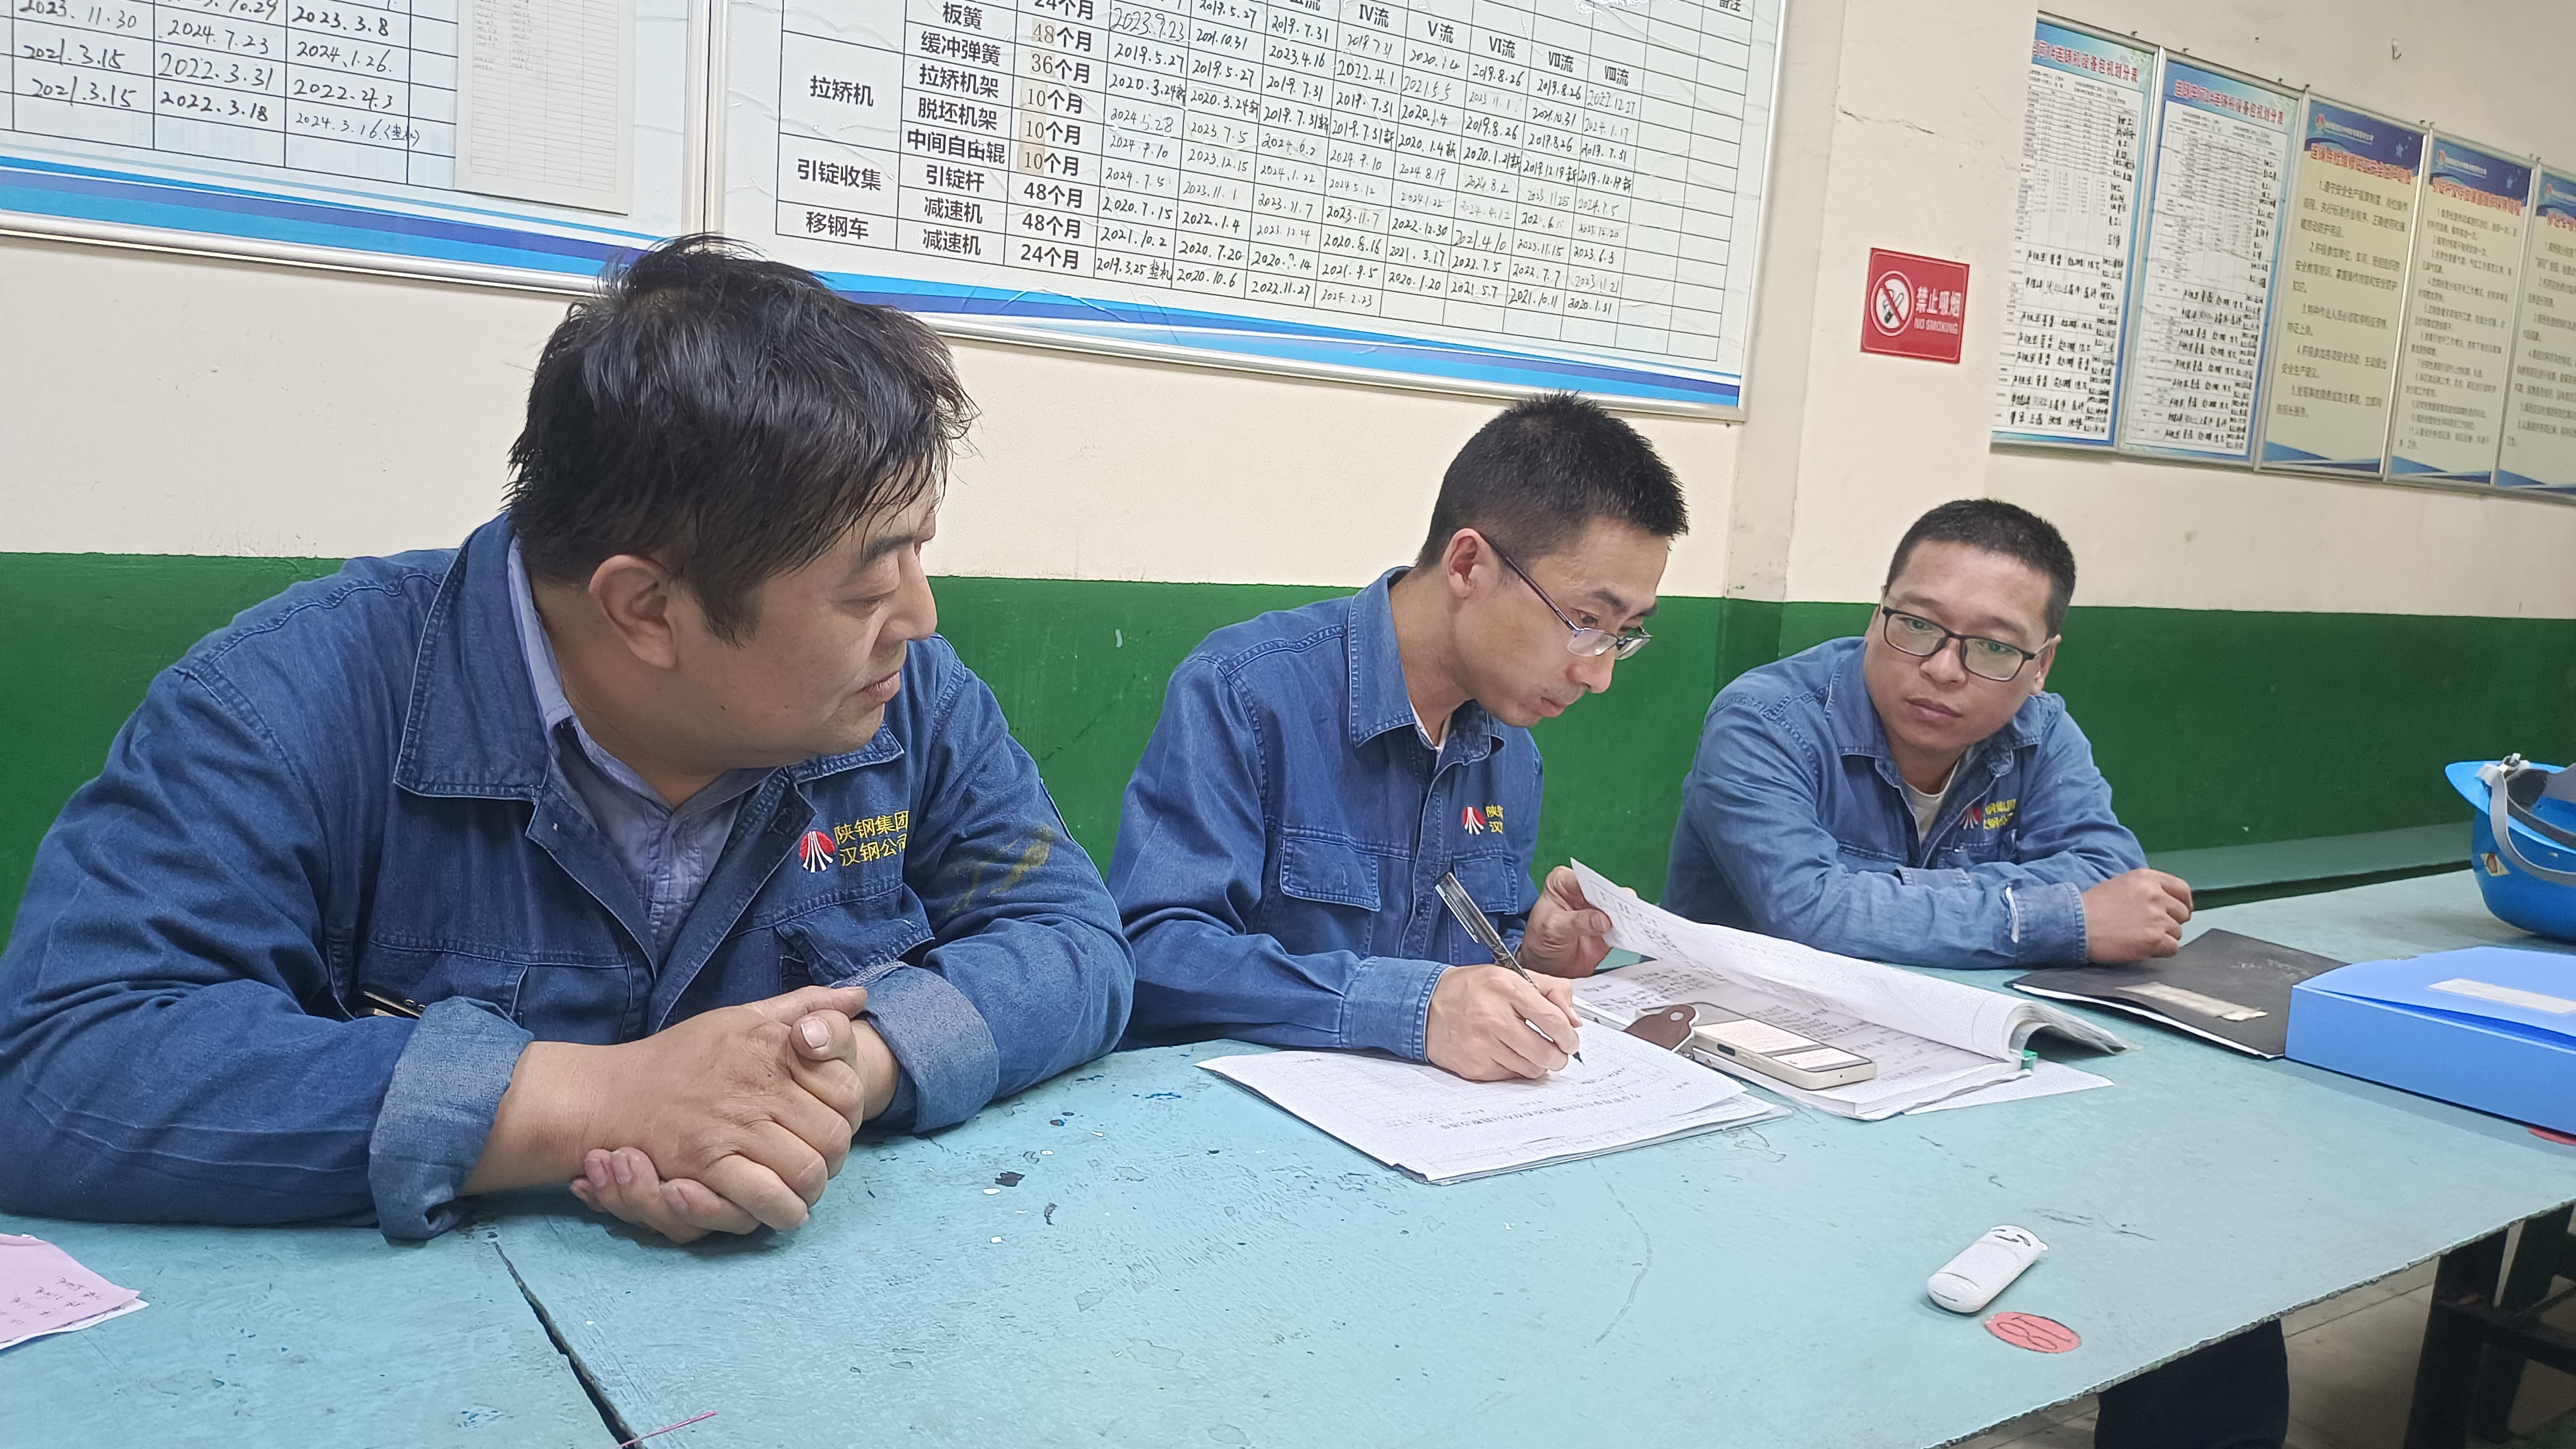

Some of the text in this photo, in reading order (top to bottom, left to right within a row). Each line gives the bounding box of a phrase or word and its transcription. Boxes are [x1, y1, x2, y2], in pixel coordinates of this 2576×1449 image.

[292, 7, 389, 37] 2023.3.8
[943, 2, 983, 30] 板簧
[1271, 16, 1328, 42] 2019.7.31
[168, 20, 269, 55] 2024.7.23
[921, 31, 1001, 67] 缓冲弹簧
[1033, 22, 1092, 53] 48个月
[1031, 53, 1090, 83] 36个月
[1114, 44, 1184, 73] 2019.5.27
[1270, 46, 1325, 67] 2023.4.16
[159, 53, 272, 90] 2022.3.31
[920, 63, 999, 98] 拉矫机架
[1192, 59, 1254, 87] 2019.5.27
[32, 76, 136, 108] 2021.3.15
[293, 79, 392, 110] 2022.4.3
[810, 75, 874, 107] 拉矫机
[1026, 88, 1083, 115] 10个月
[1267, 77, 1323, 101] 2019.7.31
[161, 91, 268, 121] 2022.3.18
[918, 97, 997, 131] 脱坯机架
[1025, 120, 1081, 145] 10个月
[798, 159, 881, 191] 引锭收集
[1024, 150, 1079, 176] 10个月
[926, 164, 984, 192] 引锭杆
[1024, 182, 1082, 209] 48个月
[924, 197, 982, 224] 减速机
[1182, 211, 1240, 234] 2022.1.4
[806, 212, 869, 240] 移钢车
[1022, 212, 1081, 239] 48个月
[922, 229, 981, 255] 减速机
[1020, 244, 1079, 270] 24个月
[1914, 318, 1925, 330] NO
[834, 811, 909, 845] 陕钢集团
[840, 834, 907, 866] 汉钢公司
